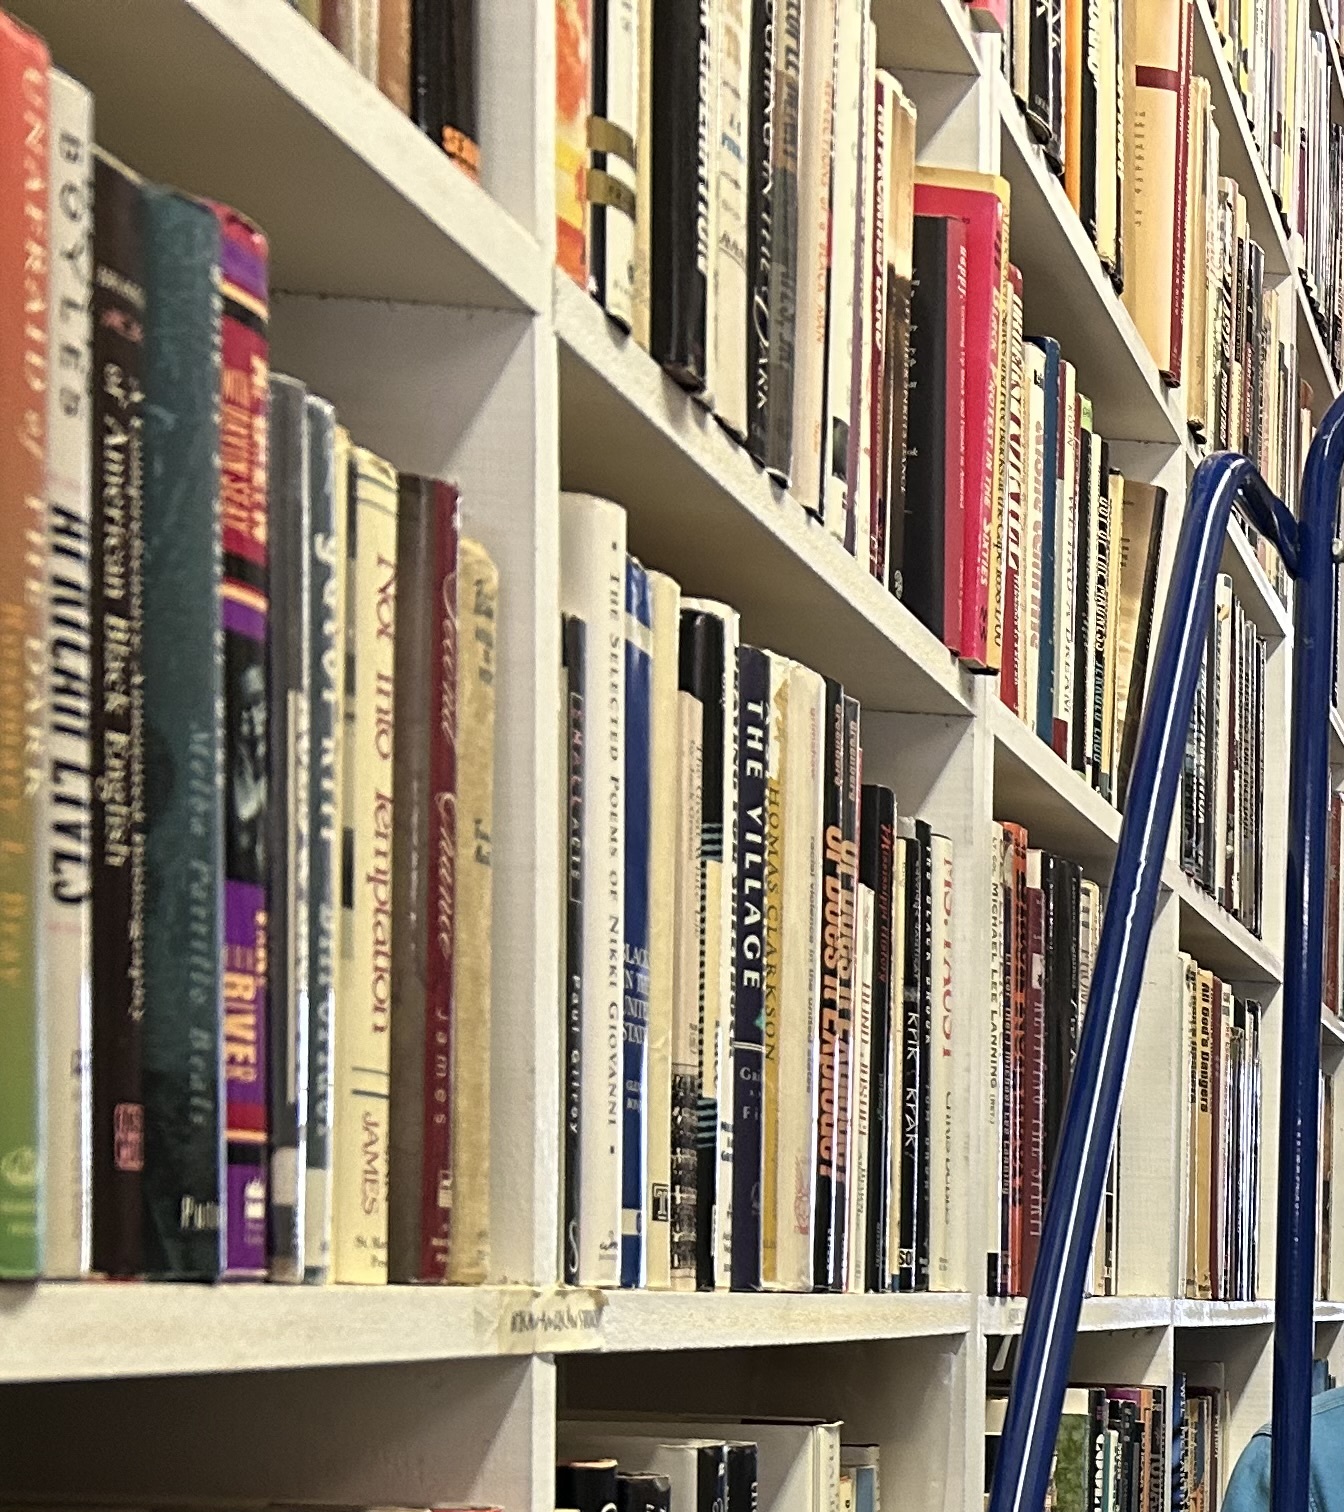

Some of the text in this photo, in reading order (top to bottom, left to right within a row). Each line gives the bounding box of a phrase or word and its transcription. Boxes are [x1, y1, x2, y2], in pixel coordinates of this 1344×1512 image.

[978, 354, 1001, 588] PROTEST SIXTIES
[742, 700, 766, 989] THE VILLAGE
[223, 970, 258, 1084] RIVER
[607, 1002, 620, 1128] GIOVANNI
[362, 1109, 380, 1218] JAMES
